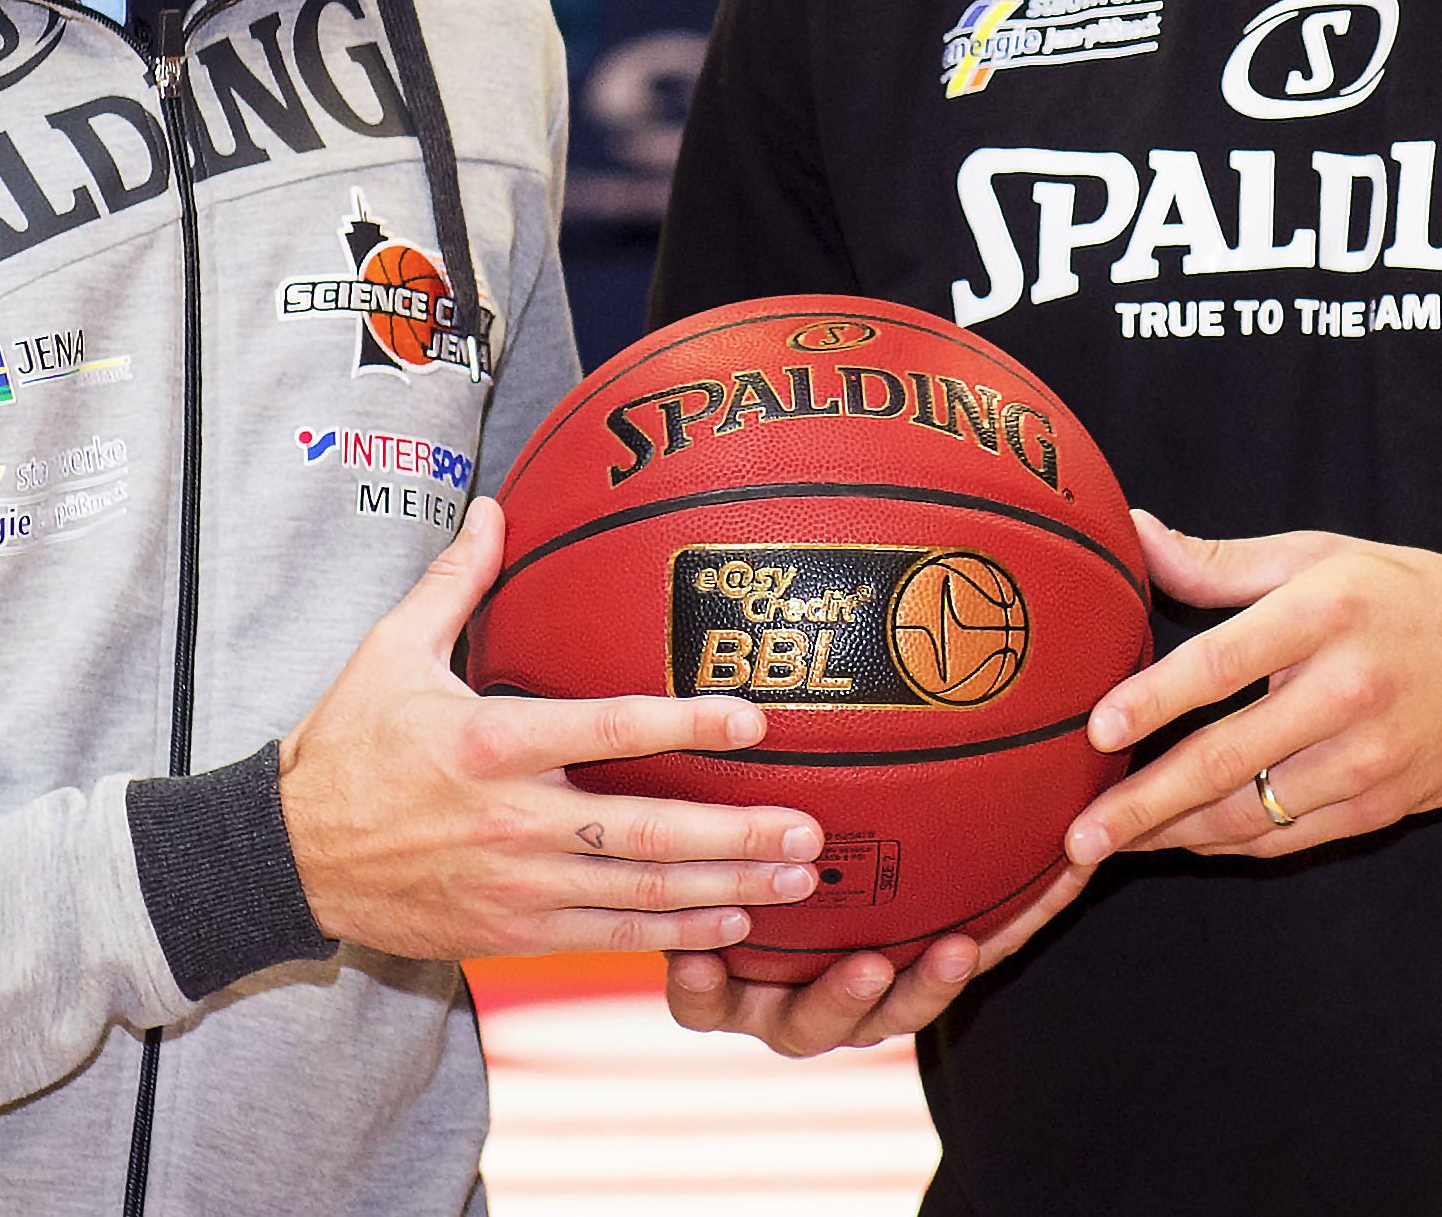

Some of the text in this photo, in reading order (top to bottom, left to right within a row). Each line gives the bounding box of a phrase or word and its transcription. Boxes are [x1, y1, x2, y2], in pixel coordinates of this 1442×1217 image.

[284, 280, 429, 321] SCIENCE
[1114, 299, 1225, 338] TRUE
[1234, 298, 1284, 335] TO
[1294, 298, 1366, 337] THE
[14, 329, 85, 375] JENA
[606, 366, 1061, 492] SPALDING
[360, 484, 456, 530] MEIER
[696, 561, 797, 598] e@sy
[695, 628, 855, 692] BBL
